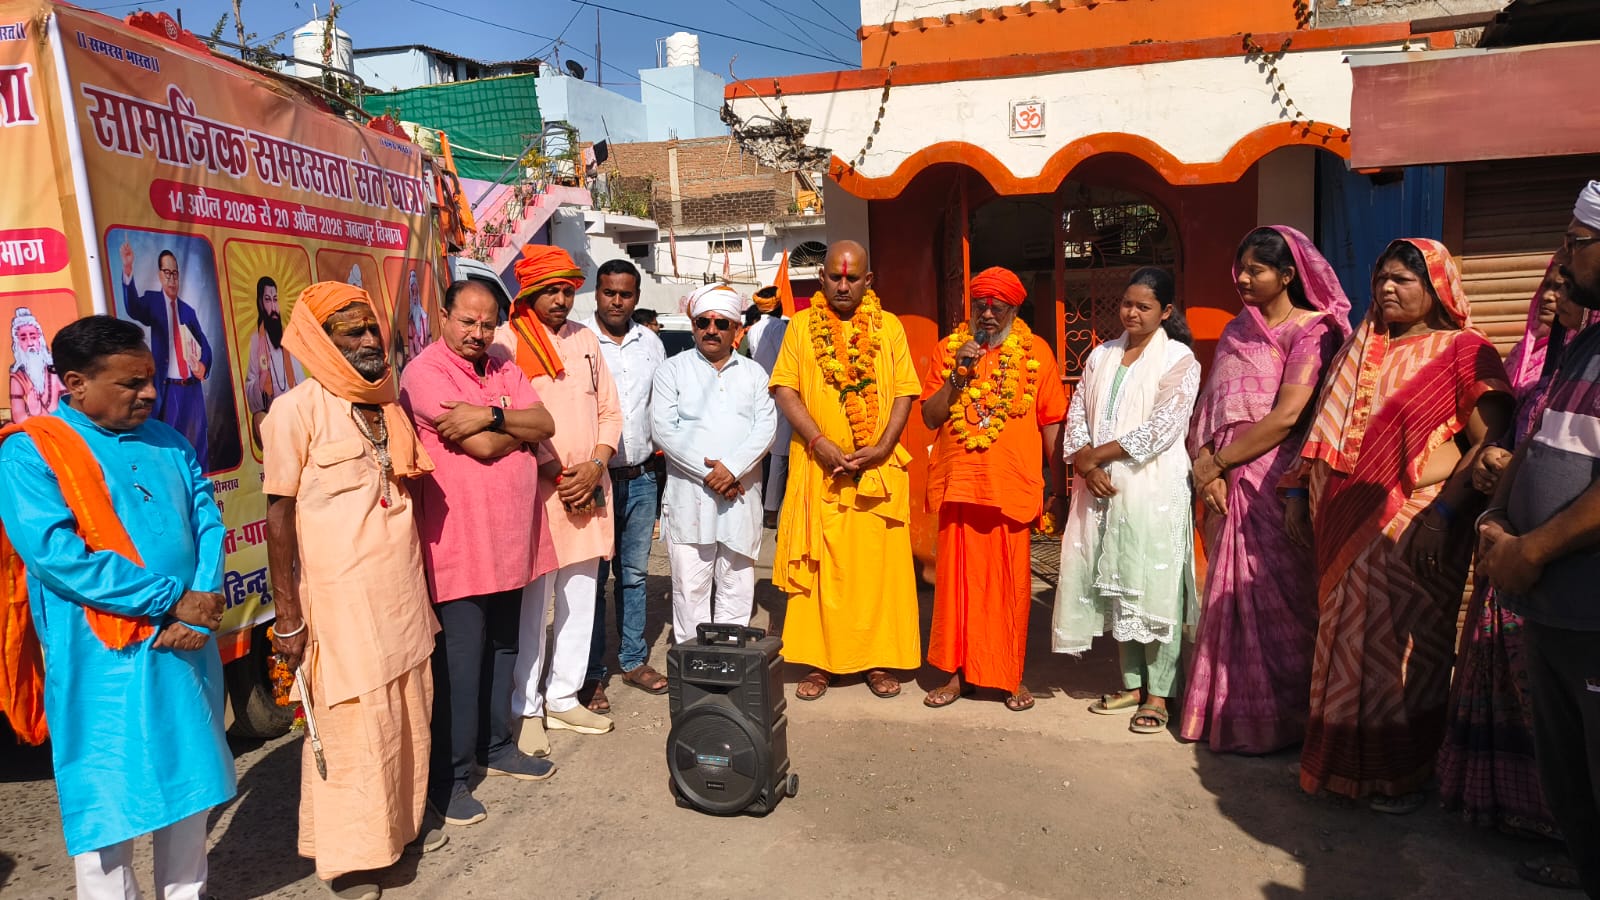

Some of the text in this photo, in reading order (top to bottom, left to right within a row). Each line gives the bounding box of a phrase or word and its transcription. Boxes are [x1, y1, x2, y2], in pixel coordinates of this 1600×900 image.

[88, 37, 124, 61] समरस
[81, 83, 249, 178] सामाजिक
[249, 130, 353, 201] समरसता
[351, 148, 390, 208] संत
[384, 168, 426, 216] यात्रा
[168, 190, 184, 214] 14
[187, 187, 221, 219] अप्रैल
[223, 200, 257, 224] 2026
[259, 199, 272, 226] से
[274, 208, 289, 228] 20
[292, 205, 318, 232] अप्रैल
[319, 215, 343, 236] 2026
[344, 220, 374, 246] जबलपुर
[0, 238, 45, 266] भाग
